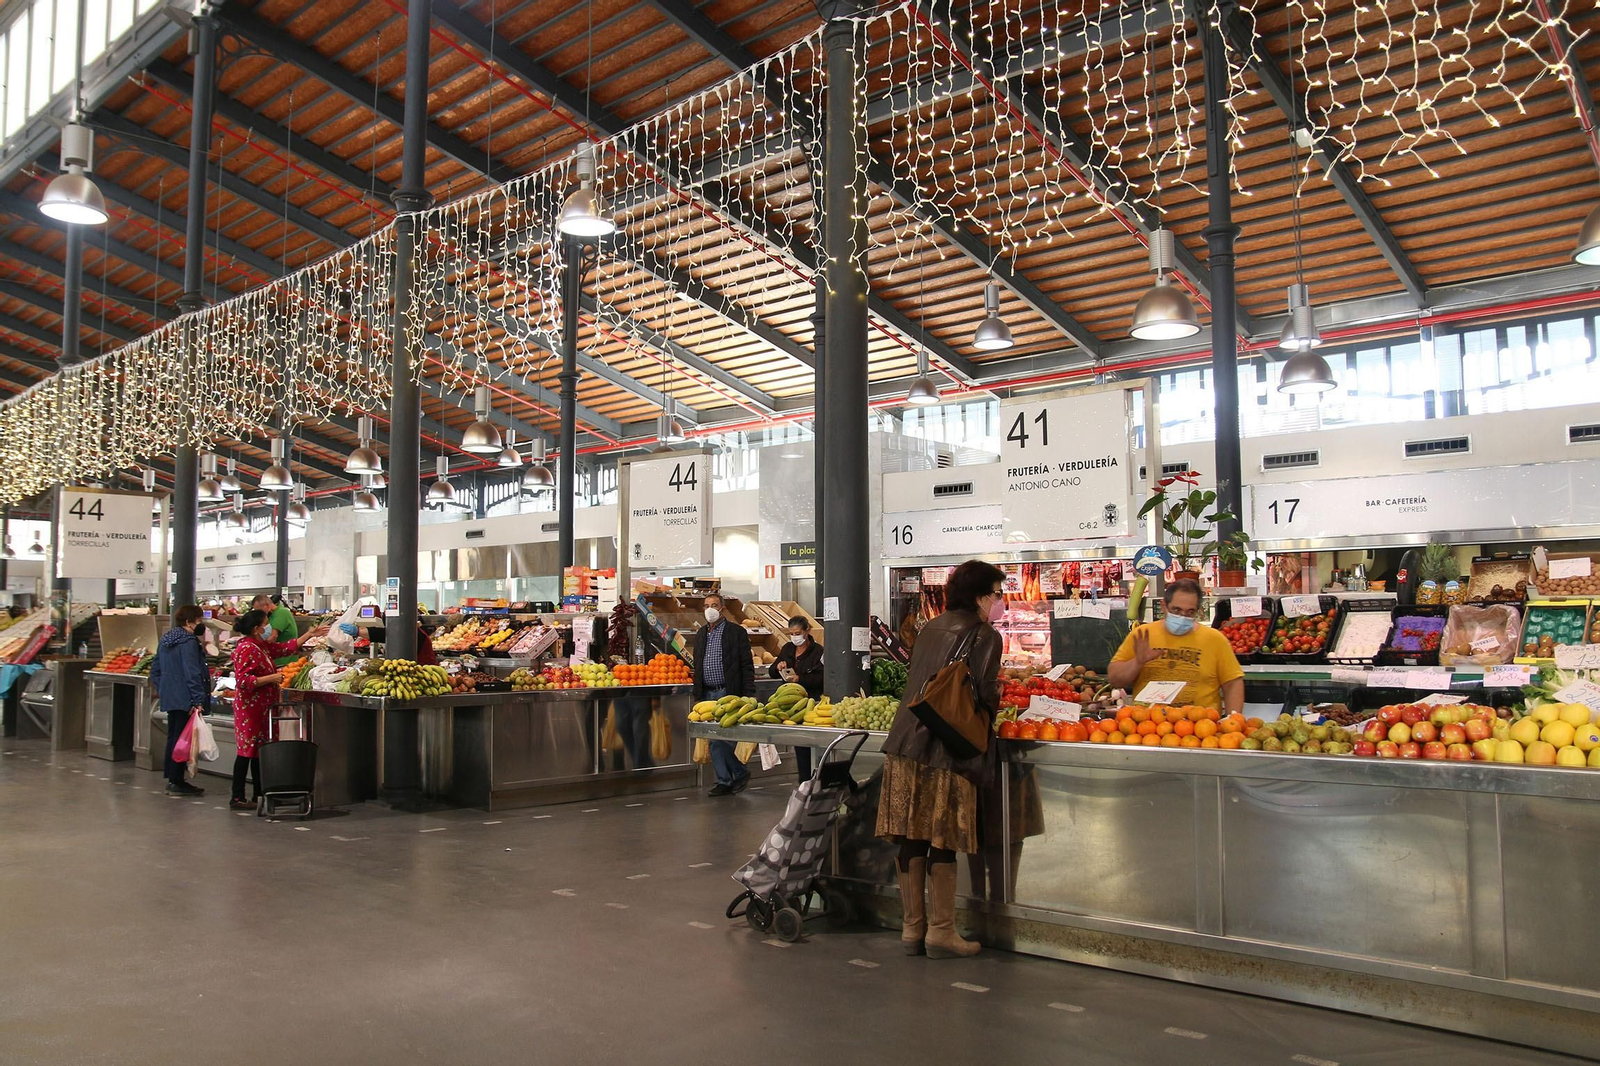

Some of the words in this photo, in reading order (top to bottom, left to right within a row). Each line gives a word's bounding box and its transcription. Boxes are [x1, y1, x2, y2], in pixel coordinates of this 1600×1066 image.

[1006, 408, 1048, 449] 41
[1007, 462, 1050, 477] FRUTERÍA
[1058, 455, 1118, 472] VERDULERÍA
[668, 461, 698, 492] 44
[1008, 479, 1050, 492] ANTONIO
[1051, 476, 1082, 488] CANO
[68, 497, 105, 521] 44
[632, 506, 658, 517] FRUTERÍA
[662, 503, 698, 515] VERDULERÍA
[1268, 498, 1301, 525] 17
[1398, 505, 1428, 514] EXPRESS
[663, 517, 698, 527] TORRECILLAS
[941, 525, 974, 533] CARNICERÍA
[1078, 521, 1098, 530] C-6.2
[105, 532, 147, 540] VERDULERÍA
[891, 524, 913, 546] 16
[68, 540, 110, 548] TORRECILLAS
[789, 545, 797, 555] la
